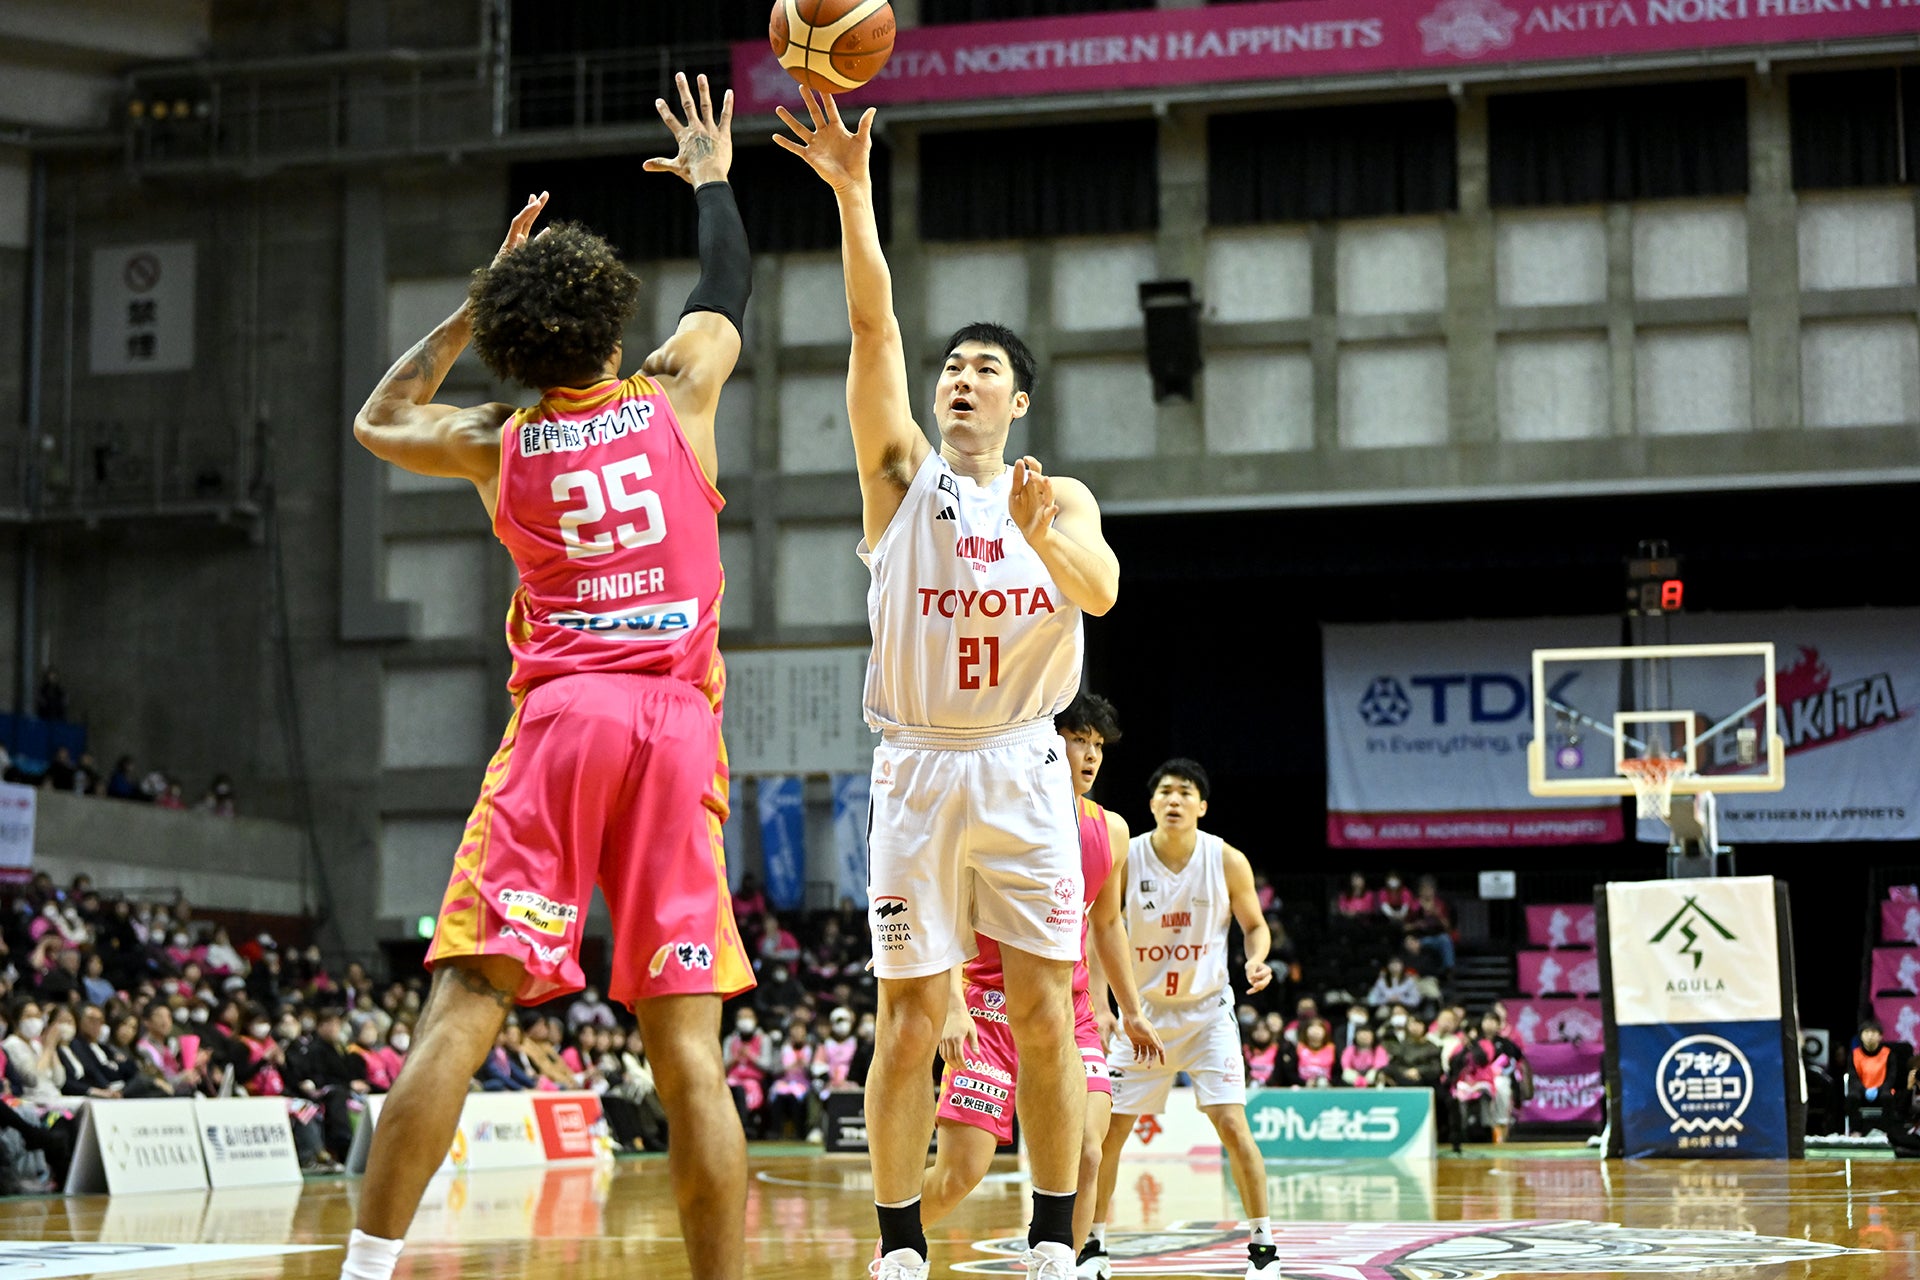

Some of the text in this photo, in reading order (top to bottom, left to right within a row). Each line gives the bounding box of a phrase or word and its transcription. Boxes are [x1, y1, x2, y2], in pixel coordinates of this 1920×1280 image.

[1524, 3, 1638, 35] AKITA
[878, 18, 1383, 79] ITA NORTHERN HAPPINETS
[523, 404, 650, 454] 龍角散ダイレクト
[551, 453, 667, 559] 25
[956, 535, 1005, 563] ALVARK
[576, 567, 665, 602] PINDER
[1661, 580, 1684, 610] 8
[918, 587, 1055, 618] TOYOTA
[959, 636, 1000, 690] 21
[1410, 670, 1582, 725] TDK
[1815, 805, 1905, 821] HAPPINETS
[524, 910, 549, 929] Nikon
[877, 923, 910, 932] TOYOTA
[1161, 911, 1192, 928] ALVARK
[1165, 971, 1179, 996] 9
[1665, 979, 1725, 992] AQULA
[1674, 1051, 1732, 1076] アキタ
[969, 1079, 1007, 1100] コスモ工具
[1668, 1076, 1742, 1101] ウミヨコ
[963, 1096, 1002, 1117] 秋田銀行
[1252, 1106, 1399, 1141] かんきょう
